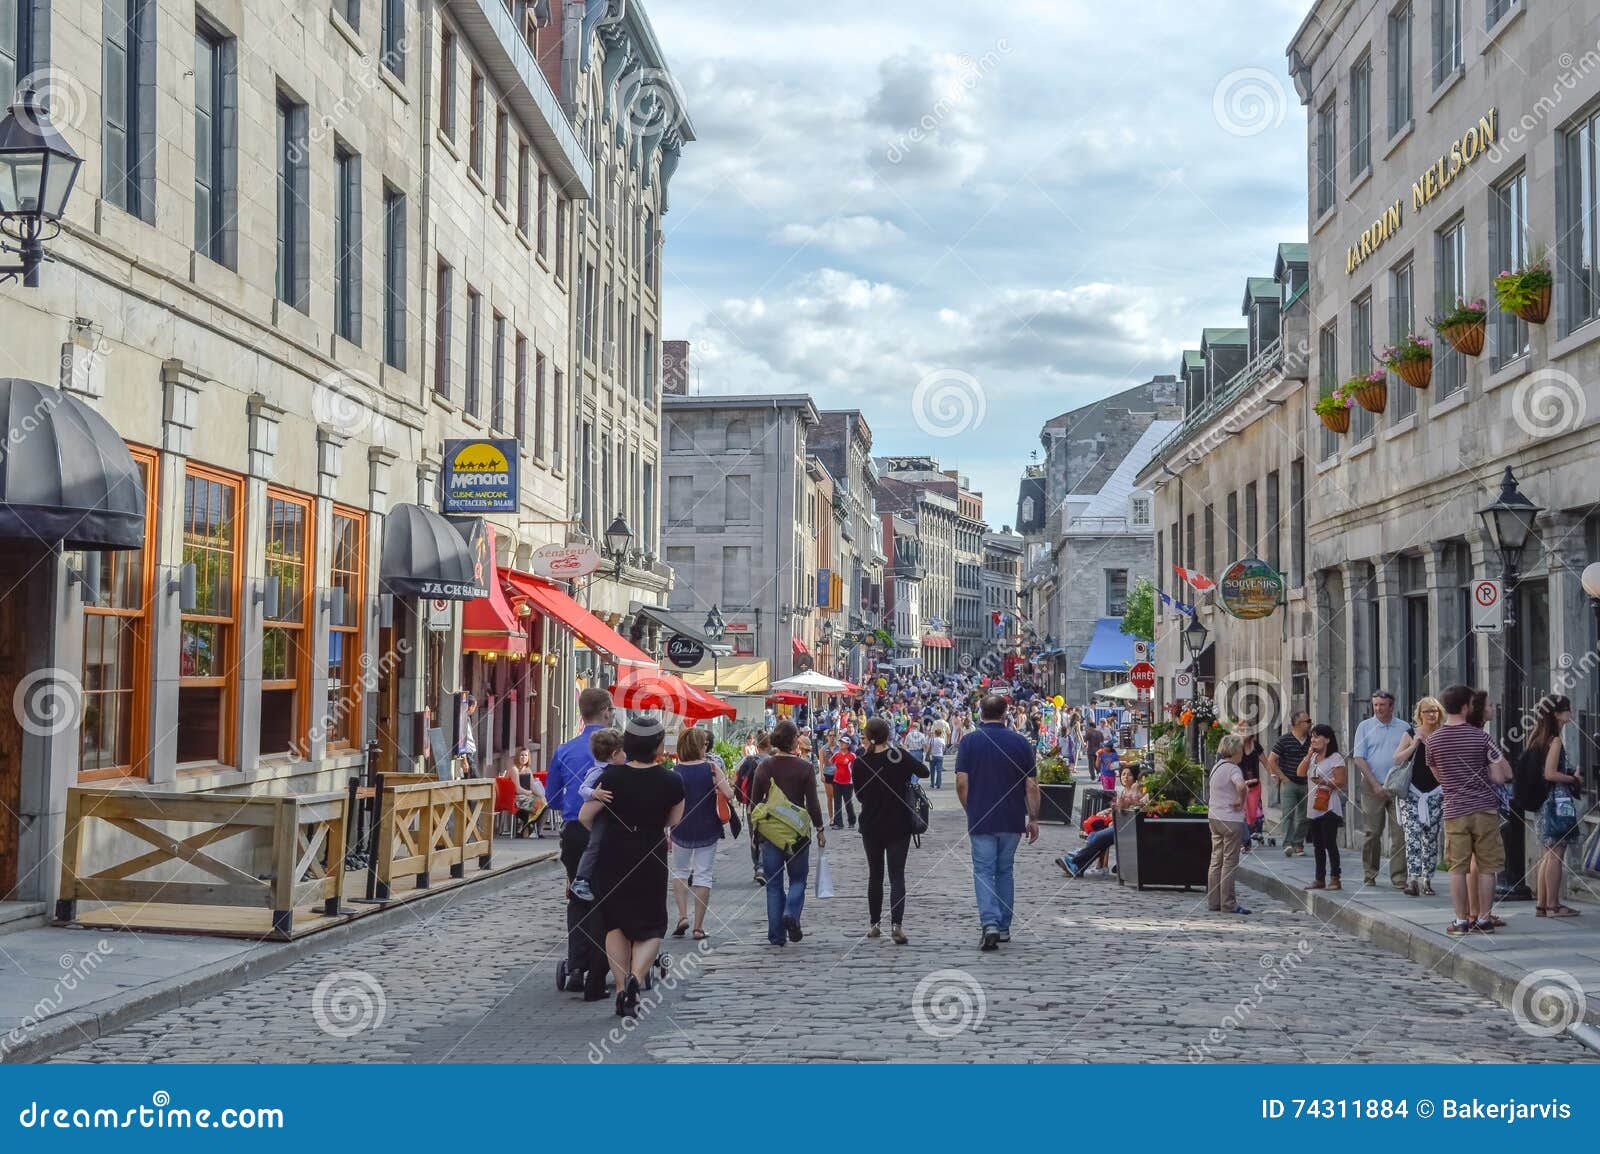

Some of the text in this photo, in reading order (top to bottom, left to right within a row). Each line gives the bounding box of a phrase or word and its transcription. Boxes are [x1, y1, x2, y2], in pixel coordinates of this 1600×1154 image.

[1345, 104, 1498, 275] JARDIN NELSON
[451, 473, 509, 489] Menara
[421, 583, 462, 595] JACK
[1225, 579, 1277, 588] SOUVENIRS
[1131, 670, 1155, 680] ARRÊT
